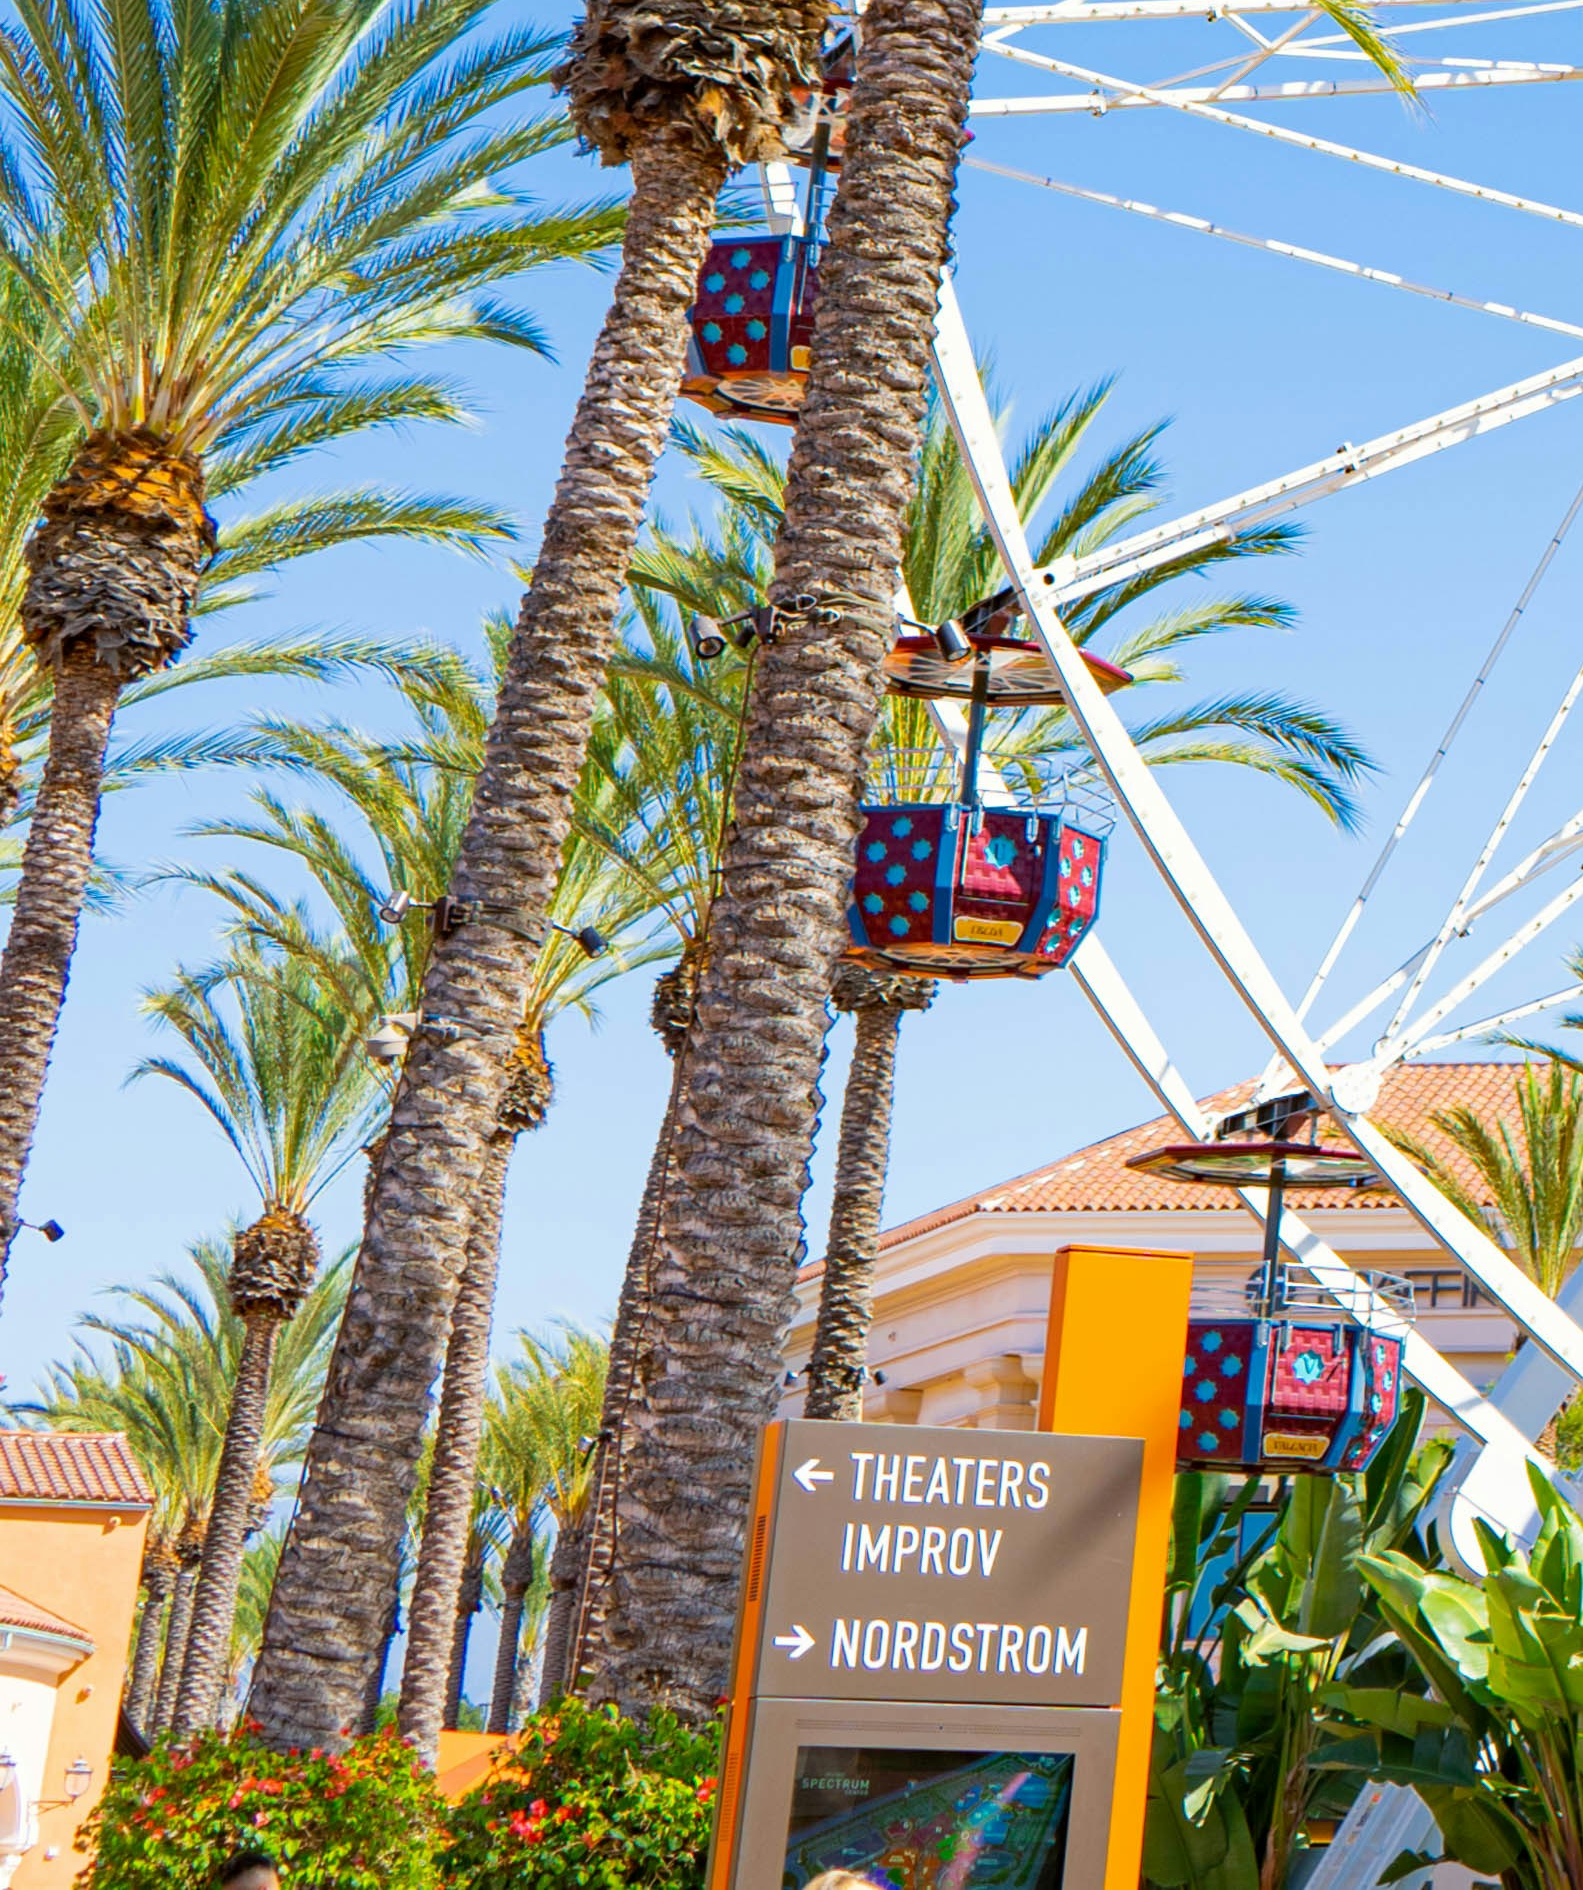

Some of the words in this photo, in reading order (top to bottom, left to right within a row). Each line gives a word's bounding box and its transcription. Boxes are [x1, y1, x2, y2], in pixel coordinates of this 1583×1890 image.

[850, 1452, 1051, 1510] THEATERS
[841, 1522, 1003, 1577] IMPROV
[830, 1618, 1088, 1675] NORDSTROM
[801, 1777, 870, 1791] SPECTRUM
